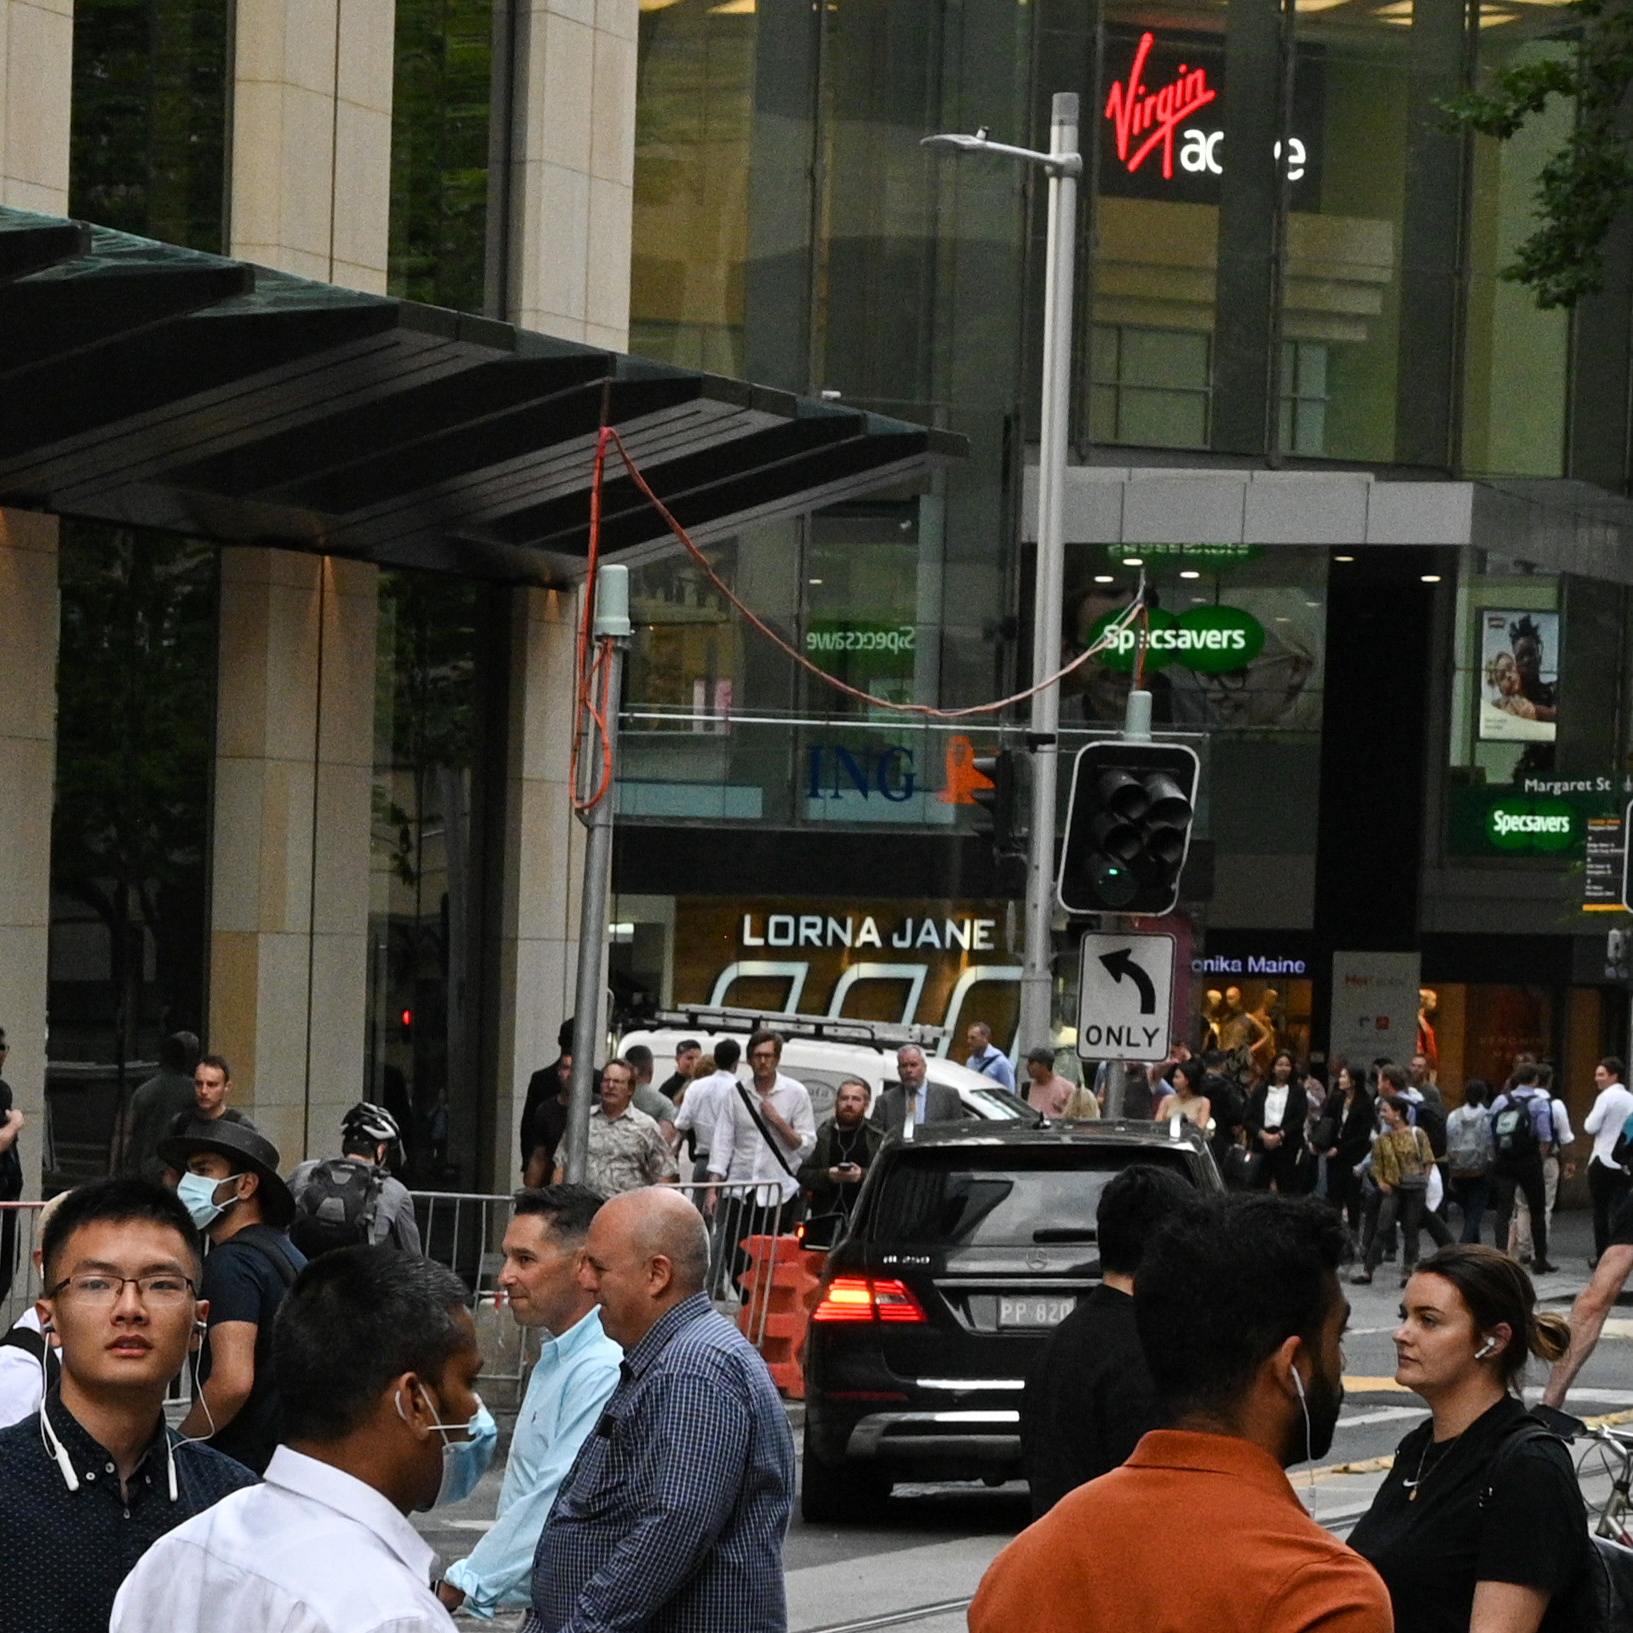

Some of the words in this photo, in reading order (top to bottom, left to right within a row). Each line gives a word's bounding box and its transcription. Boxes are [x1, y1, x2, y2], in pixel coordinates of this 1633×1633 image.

[1104, 31, 1217, 179] Virgin
[806, 743, 917, 803] ING
[1524, 778, 1592, 796] Margaret
[1596, 777, 1611, 791] St
[1493, 810, 1570, 836] Specsavers
[742, 913, 883, 948] LORNA
[892, 917, 995, 950] JANE
[1248, 956, 1306, 973] Maine
[1085, 1025, 1160, 1047] ONLY
